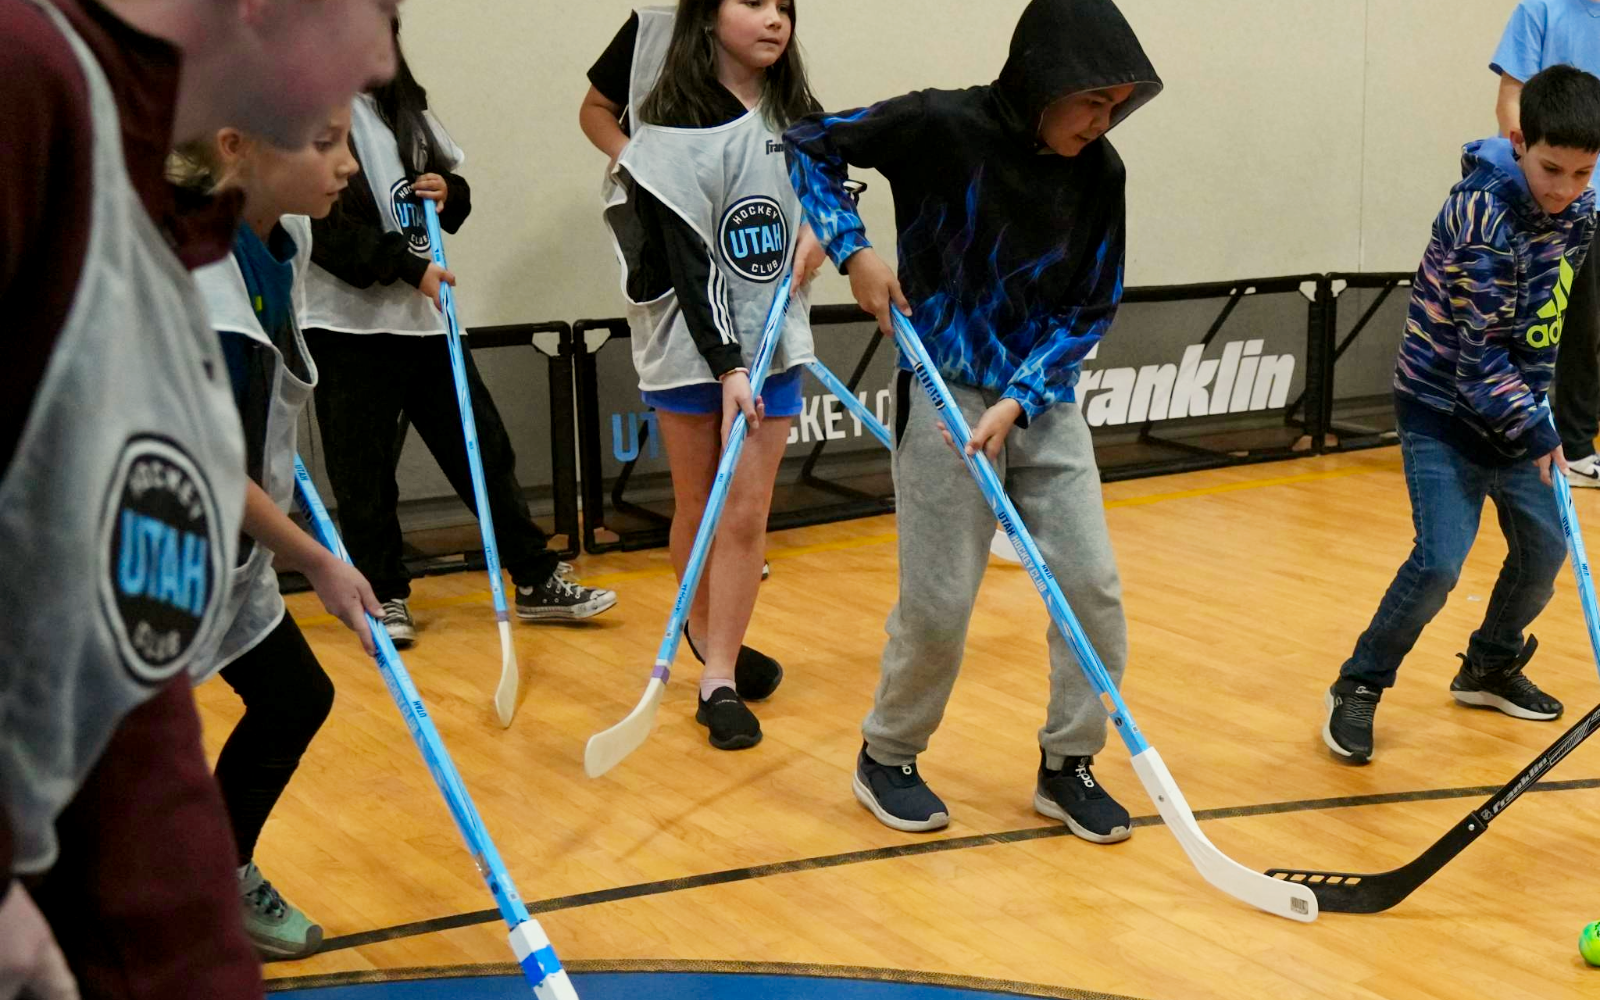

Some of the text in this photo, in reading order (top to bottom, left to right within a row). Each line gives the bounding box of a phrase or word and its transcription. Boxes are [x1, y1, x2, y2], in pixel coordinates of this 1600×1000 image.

[733, 205, 778, 225] HOCKEY
[730, 222, 782, 259] UTAH
[751, 259, 778, 274] CLUB
[118, 508, 207, 619] UTAH
[998, 511, 1016, 536] UTAH
[1011, 534, 1035, 569] HOCKEY
[1030, 567, 1048, 593] CLUB
[413, 700, 427, 718] UTAH
